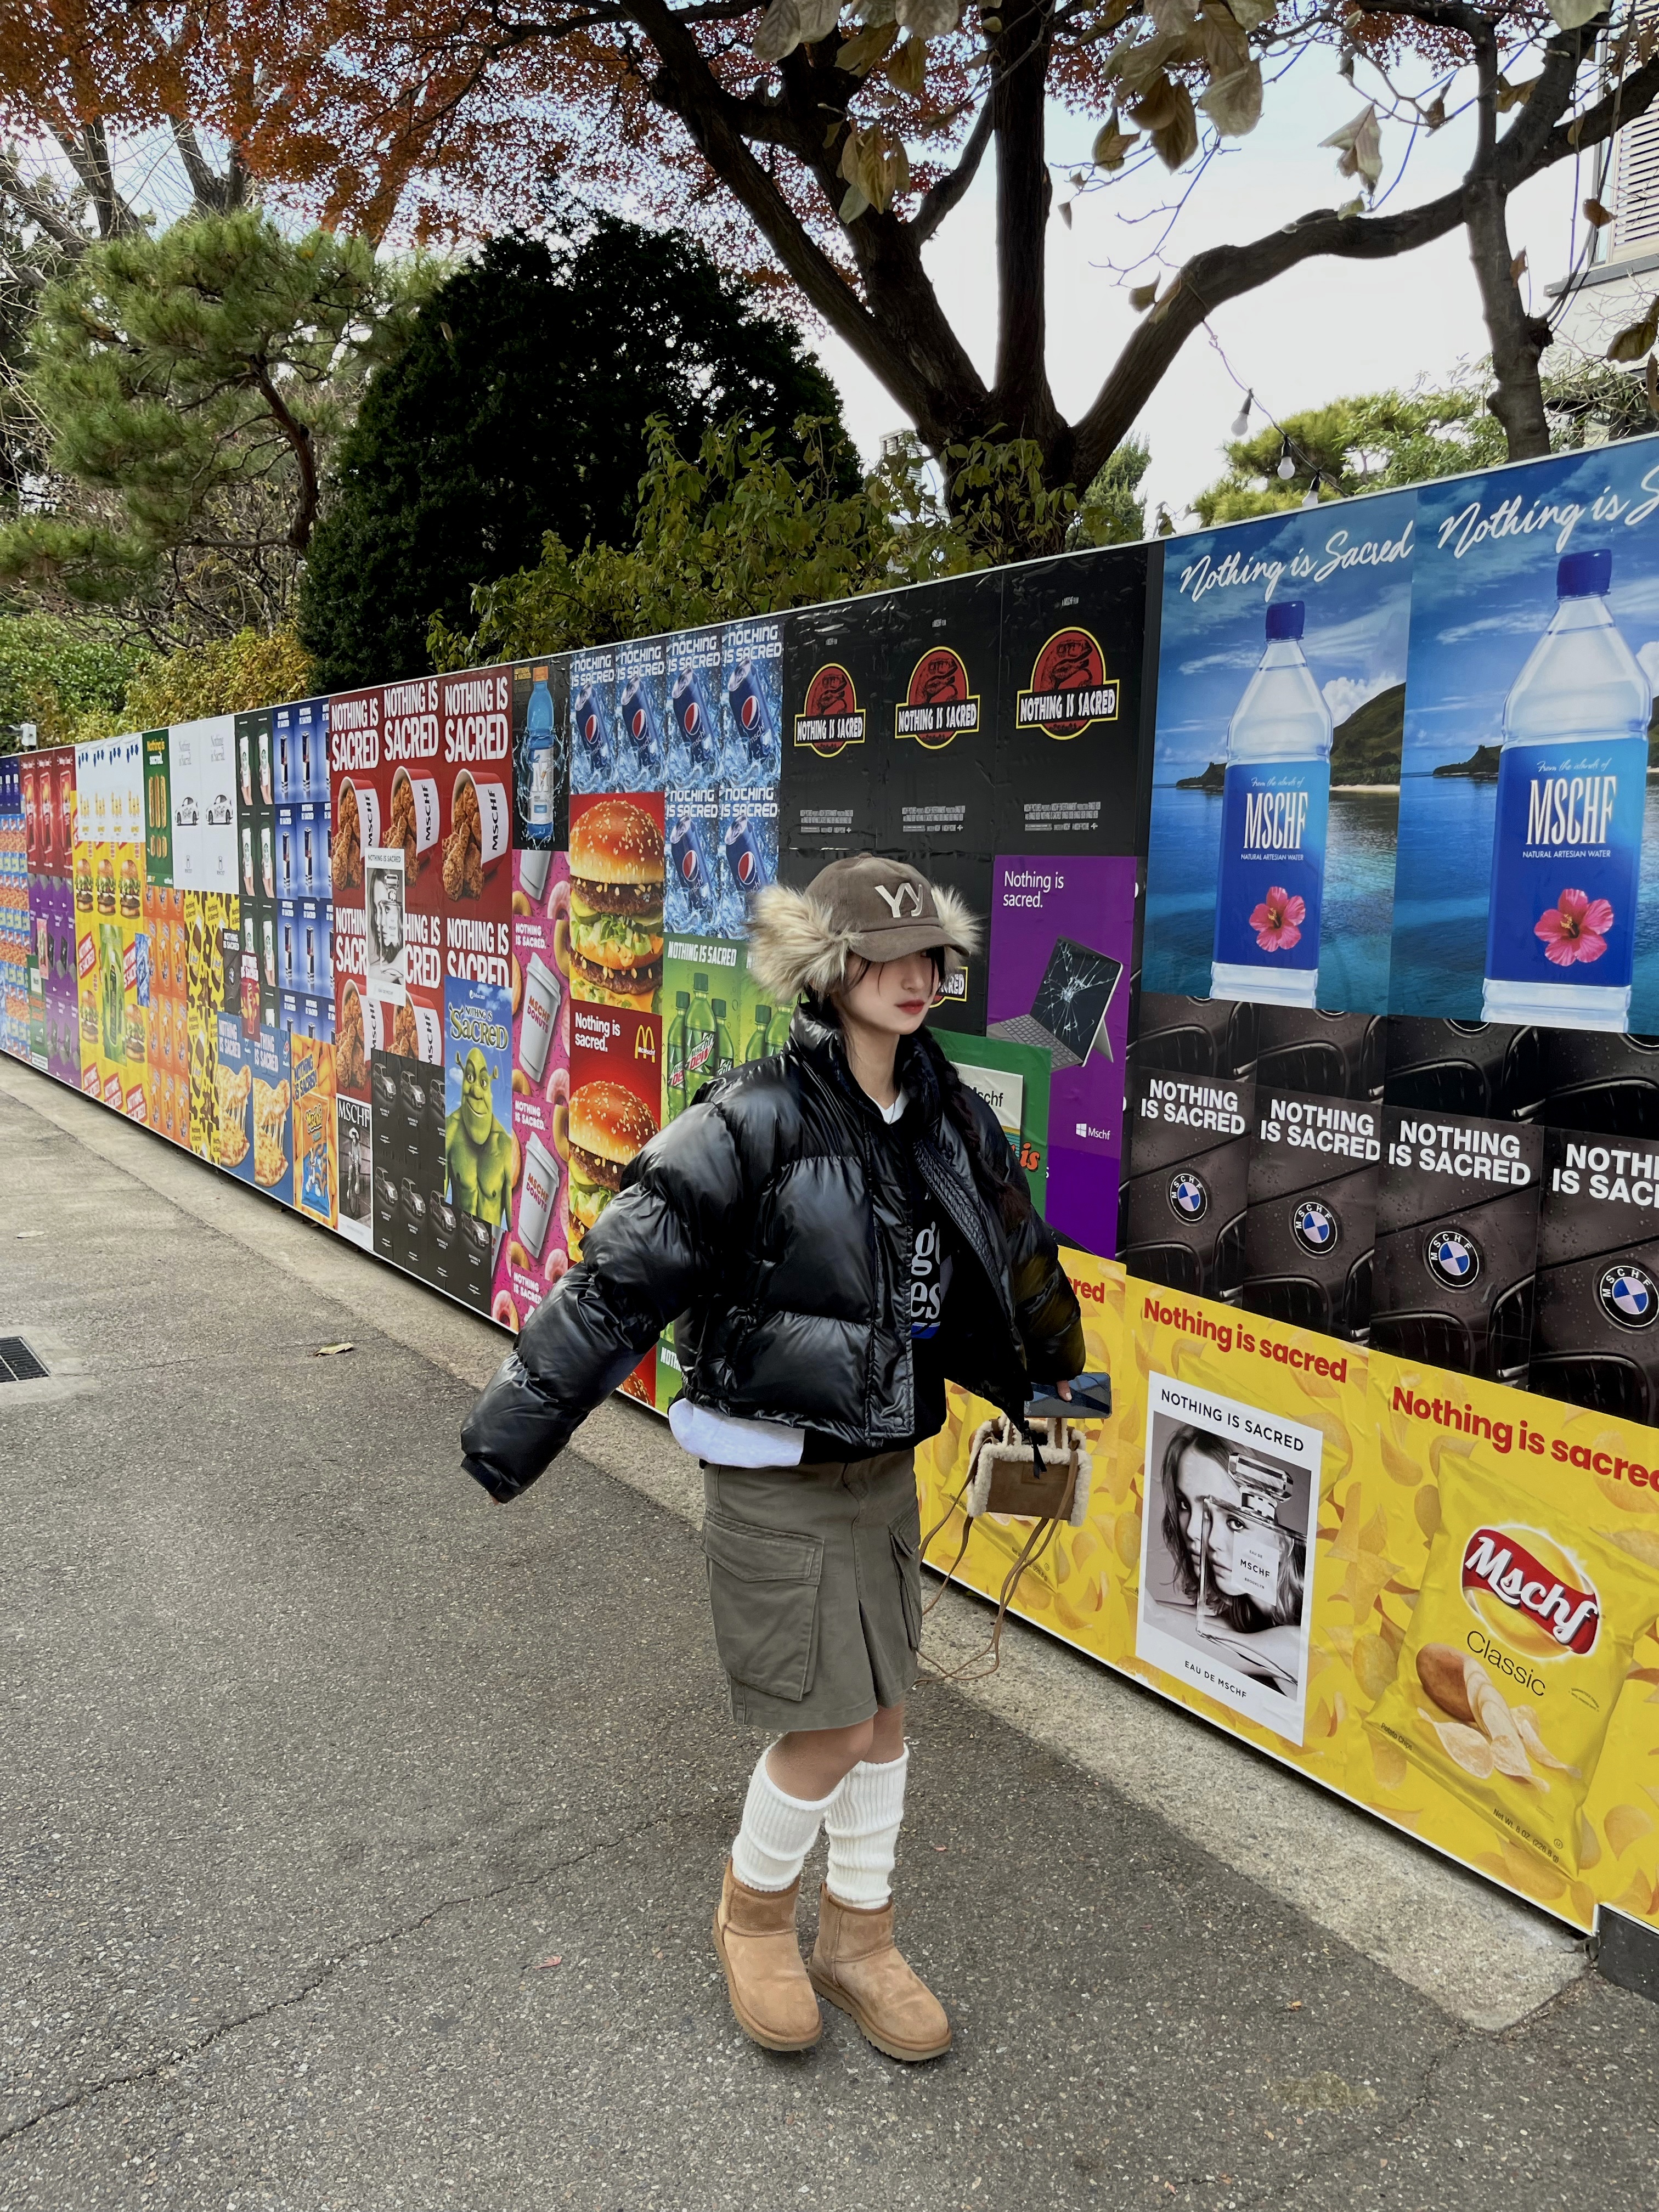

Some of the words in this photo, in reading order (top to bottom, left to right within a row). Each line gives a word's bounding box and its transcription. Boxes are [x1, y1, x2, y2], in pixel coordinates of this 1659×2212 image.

[1437, 495, 1587, 560] Nothing
[1592, 486, 1630, 521] is
[1180, 551, 1286, 602] Nothing
[1290, 548, 1319, 577] is
[1313, 520, 1414, 582] Sacred
[668, 660, 677, 673] IS
[679, 652, 720, 671] SACRED
[724, 649, 733, 664] IS
[736, 642, 782, 661] SACRED
[572, 675, 579, 687] IS
[580, 669, 614, 686] SACRED
[618, 667, 625, 680] IS
[627, 661, 665, 679] SACRED
[384, 682, 425, 718] NOTHING
[428, 680, 438, 712] IS
[445, 679, 493, 716] NOTHING
[496, 676, 508, 710] IS
[1020, 695, 1062, 722] NOTHING
[1066, 693, 1075, 718] IS
[1078, 689, 1115, 716] SACRED
[331, 699, 368, 731] NOTHING
[369, 698, 378, 726] IS
[797, 720, 827, 741] NOTHING
[829, 719, 834, 739] IS
[837, 716, 863, 738] SACRED
[898, 708, 933, 732] NOTHING
[936, 707, 943, 729] IS
[946, 703, 977, 728] SACRED
[332, 729, 379, 771] SACRED
[384, 714, 439, 761] SACRED
[445, 714, 509, 763] SACRED
[1537, 760, 1556, 772] From
[1559, 759, 1571, 772] the
[1573, 758, 1600, 770] islands
[1600, 757, 1612, 772] of
[1251, 777, 1265, 787] From
[1266, 776, 1277, 787] the
[1296, 776, 1305, 788] of
[364, 794, 373, 846] MSCHF
[421, 785, 431, 840] MSCHF
[488, 789, 499, 850] MSCHF
[667, 804, 675, 817] IS
[676, 804, 718, 818] SACRED
[721, 803, 730, 817] IS
[732, 803, 778, 817] SACRED
[1243, 792, 1308, 849] MSCHF
[1526, 776, 1617, 844] MSCHF
[1005, 871, 1051, 893] Nothing
[1055, 871, 1064, 889] is
[1003, 891, 1043, 908] sacred.
[431, 916, 441, 946] IS
[447, 918, 494, 953] NOTHING
[498, 923, 509, 955] IS
[515, 923, 542, 936] NOTHING
[515, 935, 521, 945] IS
[522, 935, 546, 949] SACRED.
[668, 941, 698, 962] NOTHING
[699, 945, 707, 963] IS
[707, 946, 737, 967] SACRED
[465, 1006, 486, 1019] NOTHING
[488, 1011, 492, 1021] IS
[527, 1005, 549, 1034] DONUTS
[529, 996, 550, 1021] MSCHF
[219, 1019, 238, 1041] NOTHING
[424, 1012, 433, 1064] MSCHF
[575, 1012, 610, 1037] Nothing
[612, 1019, 620, 1036] is
[219, 1036, 224, 1053] IS
[225, 1039, 241, 1059] SACRED
[575, 1034, 608, 1052] sacred.
[255, 1048, 259, 1065] IS
[260, 1052, 279, 1073] SACRED
[515, 1101, 541, 1117] NOTHING
[1149, 1079, 1238, 1112] NOTHING
[338, 1098, 370, 1127] MSCHF
[515, 1112, 521, 1123] IS
[522, 1114, 545, 1129] SACRED.
[1141, 1098, 1158, 1119] IS
[1164, 1102, 1245, 1135] SACRED
[1271, 1099, 1374, 1136] NOTHING
[1088, 1127, 1110, 1140] Mschf
[1261, 1120, 1281, 1142] IS
[1286, 1125, 1380, 1161] SACRED
[1400, 1120, 1520, 1159] NOTHING
[1020, 1142, 1040, 1172] is
[1389, 1143, 1412, 1167] IS
[1419, 1148, 1531, 1186] SACRED
[528, 1173, 549, 1201] MSCHF
[1171, 1175, 1202, 1199] MSCHF
[1552, 1168, 1580, 1194] IS
[526, 1182, 547, 1212] DONUTS
[1295, 1204, 1331, 1229] MSCHF
[1431, 1233, 1471, 1261] MSCHF
[514, 1272, 539, 1293] NOTHING
[514, 1283, 519, 1294] IS
[1602, 1268, 1650, 1298] MSCHF
[1144, 1297, 1232, 1352] Nothing
[1236, 1323, 1255, 1352] is
[1259, 1338, 1347, 1384] sacred
[1161, 1389, 1222, 1422] NOTHING
[1228, 1413, 1240, 1428] IS
[1244, 1420, 1304, 1452] SACRED
[1392, 1386, 1513, 1454] Nothing
[1519, 1420, 1545, 1455] is
[1240, 1559, 1270, 1577] MSCHF
[1244, 1577, 1265, 1589] BROOKLYN
[1464, 1536, 1599, 1644] Mschf
[1467, 1630, 1545, 1696] Classic
[1185, 1660, 1201, 1674] EAU
[1204, 1671, 1215, 1682] DE
[1218, 1678, 1246, 1697] MSCHF
[1381, 1723, 1397, 1739] Potato
[1398, 1736, 1413, 1751] Chips
[1493, 1808, 1504, 1820] Net
[1515, 1825, 1520, 1833] 8
[1553, 1855, 1559, 1864] g)
